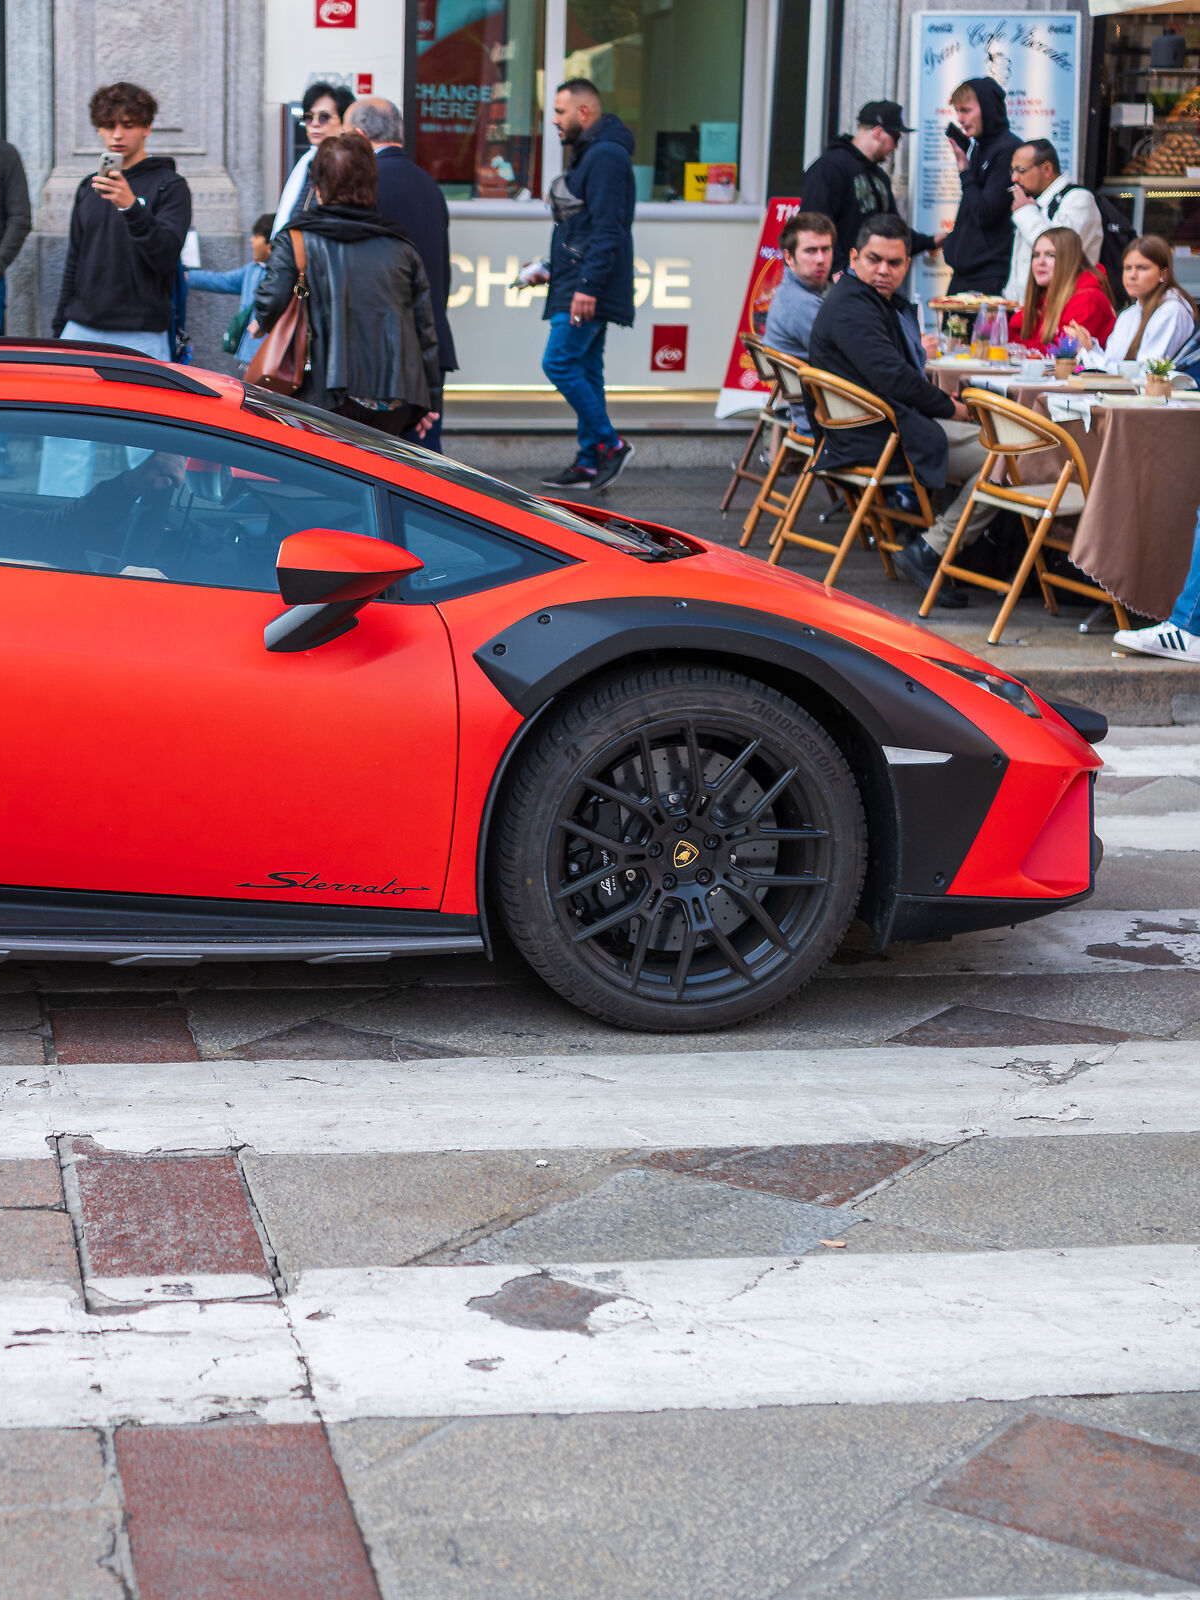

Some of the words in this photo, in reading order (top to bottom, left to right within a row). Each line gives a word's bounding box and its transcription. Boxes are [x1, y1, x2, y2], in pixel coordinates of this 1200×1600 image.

[420, 102, 477, 120] HERE
[446, 254, 692, 309] CHE
[750, 699, 841, 788] BRIDGESTONE
[235, 871, 432, 895] Sterrato
